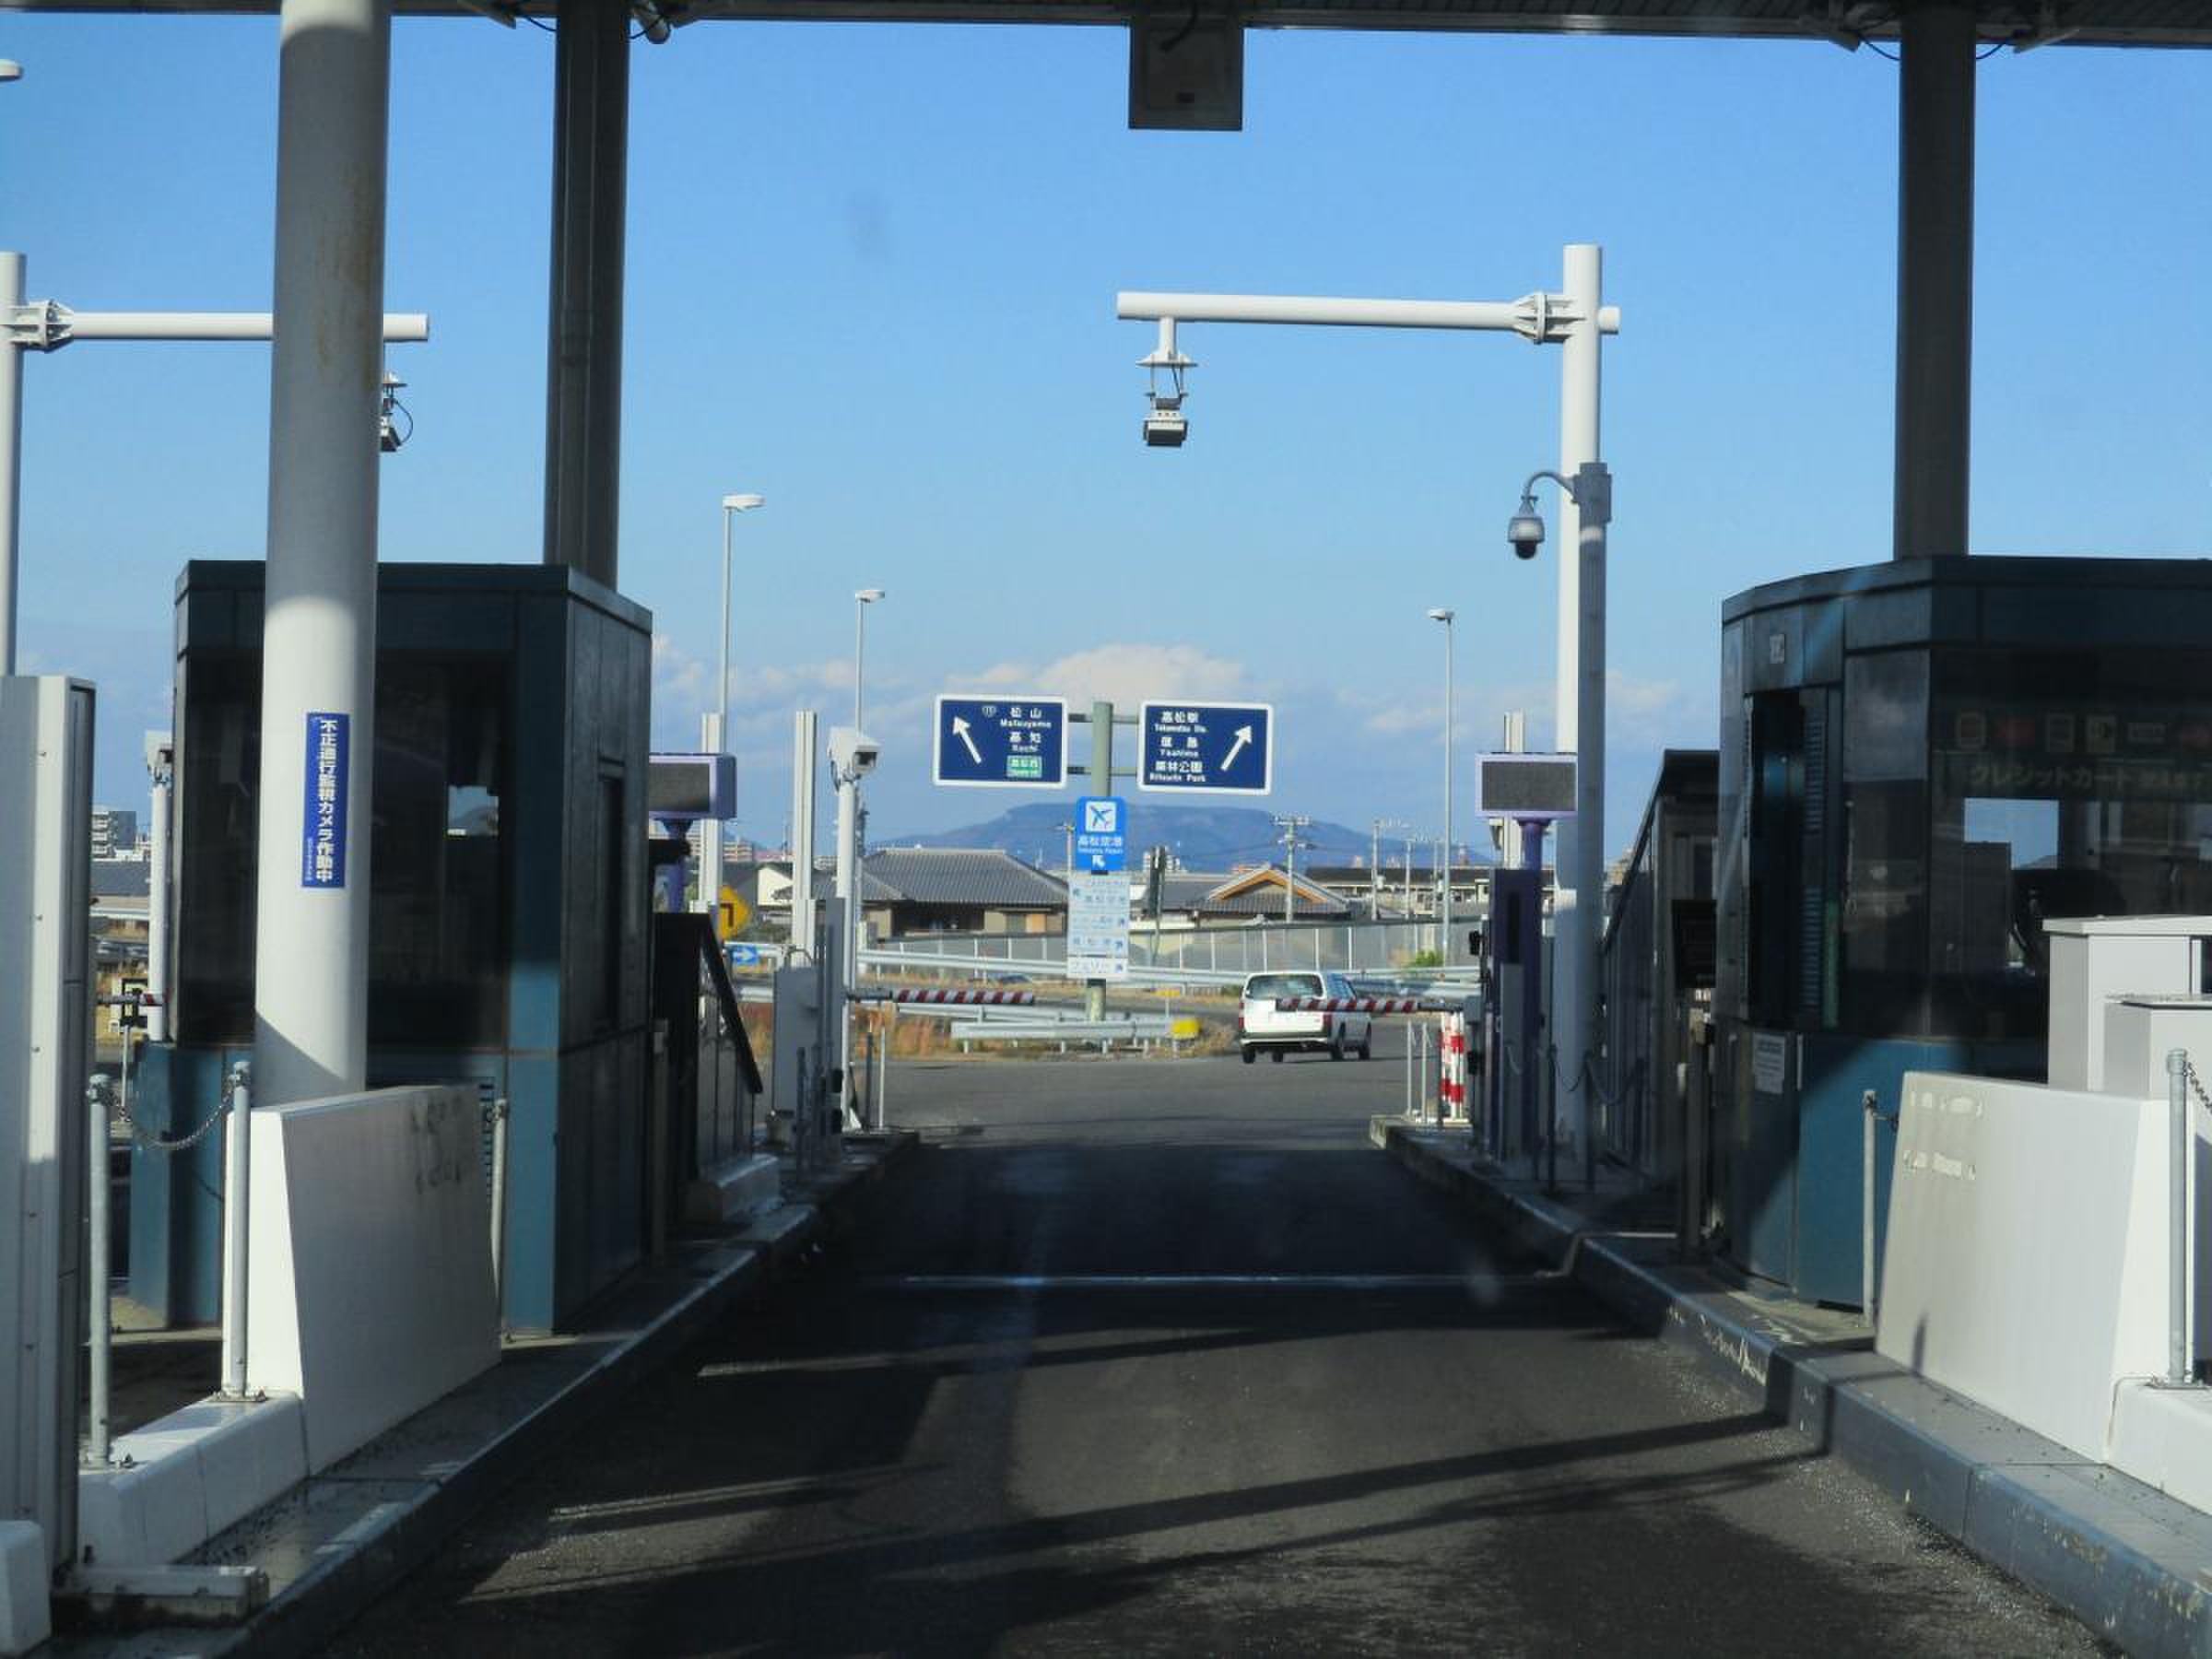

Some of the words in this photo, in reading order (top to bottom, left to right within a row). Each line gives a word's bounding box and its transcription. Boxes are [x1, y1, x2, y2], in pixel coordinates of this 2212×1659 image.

[1010, 707, 1041, 719] 松山
[1160, 711, 1199, 724] 高松駅
[1000, 718, 1052, 729] Matsuyama
[1010, 731, 1041, 744] 高知
[1155, 760, 1203, 773] 栗林公園
[316, 719, 338, 883] 不正通行監視カメラ作動中
